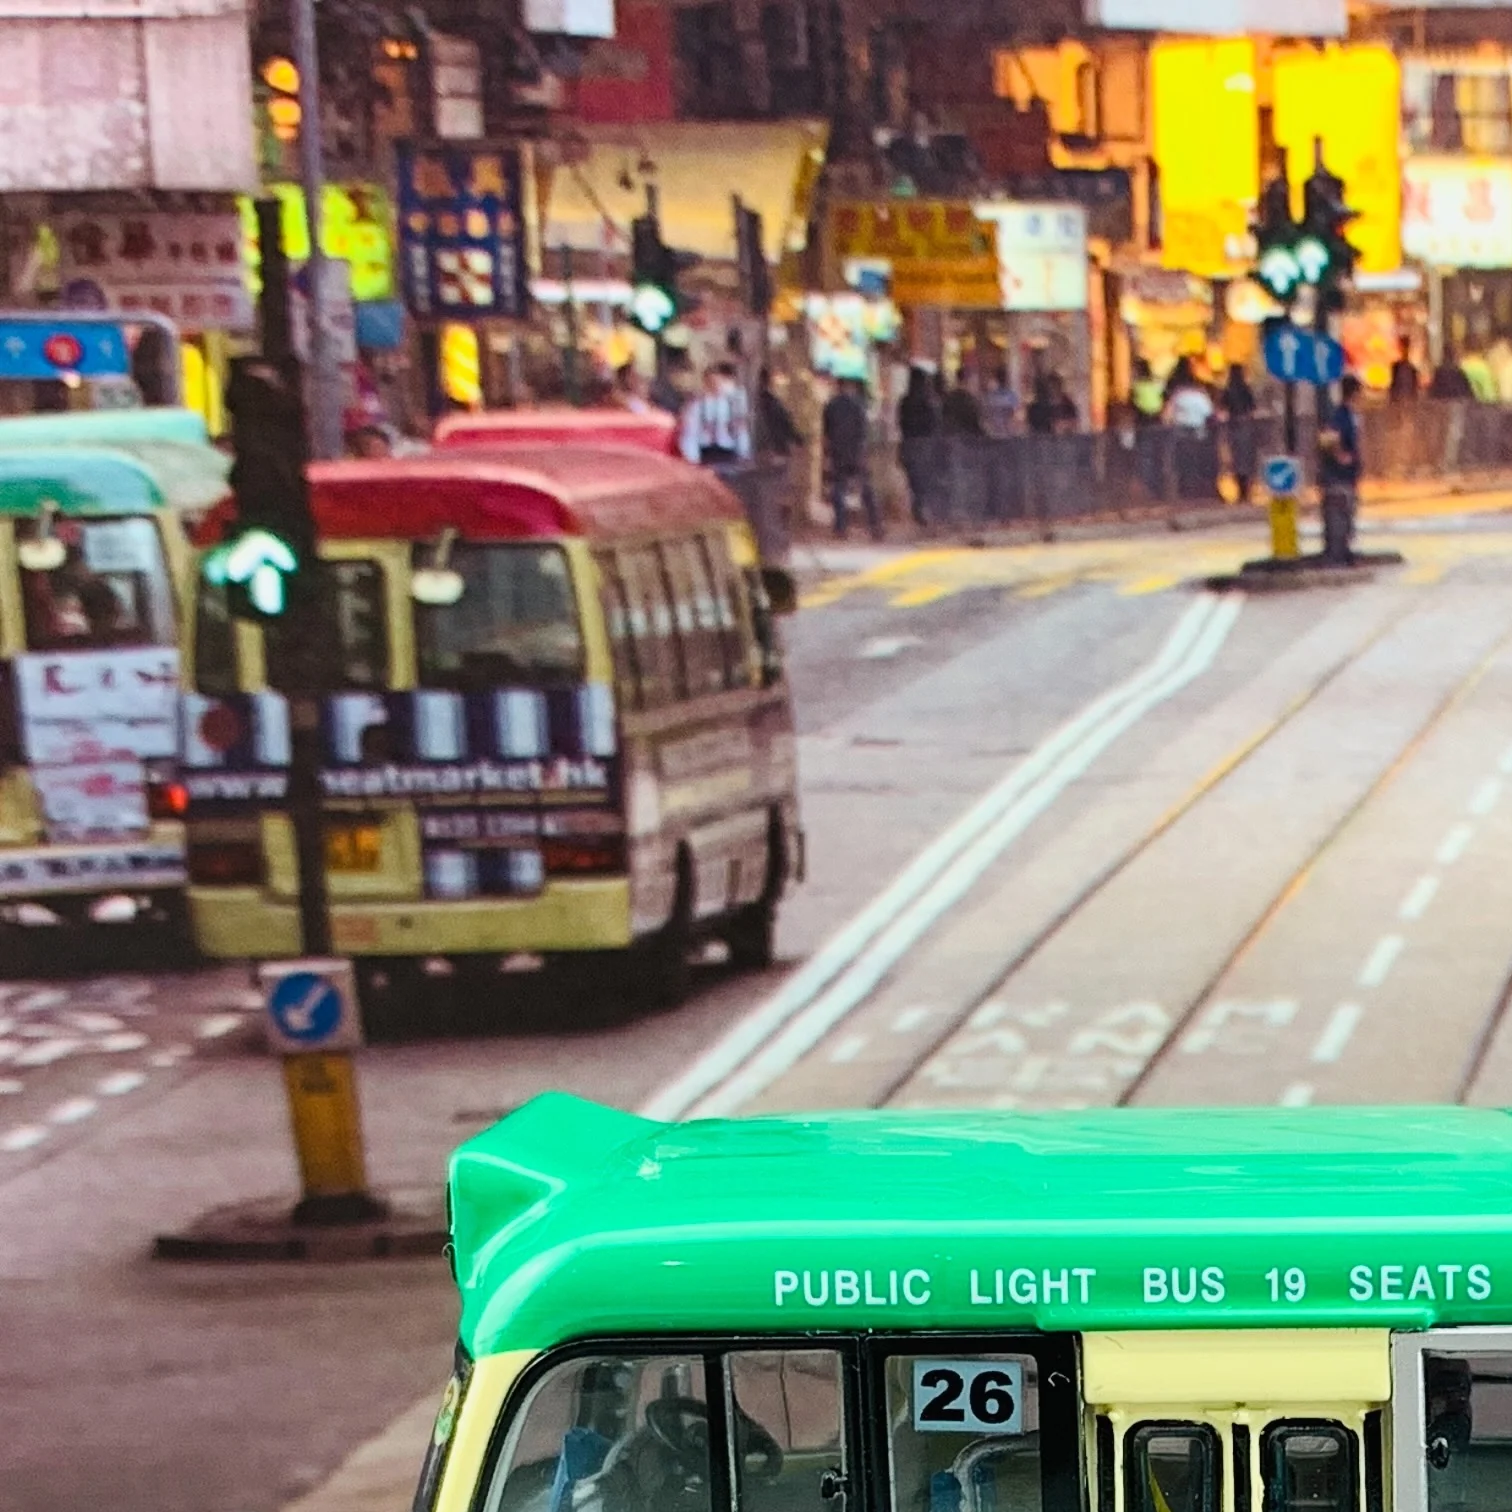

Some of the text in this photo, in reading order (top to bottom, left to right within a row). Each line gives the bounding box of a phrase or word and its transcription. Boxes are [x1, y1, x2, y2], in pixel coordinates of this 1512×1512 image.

[773, 1268, 932, 1306] PUBLIC
[969, 1266, 1097, 1305] LIGHT
[1142, 1266, 1227, 1304] BUS
[1264, 1267, 1307, 1303] 19
[1348, 1263, 1493, 1302] SEATS
[918, 1369, 1015, 1425] 26
